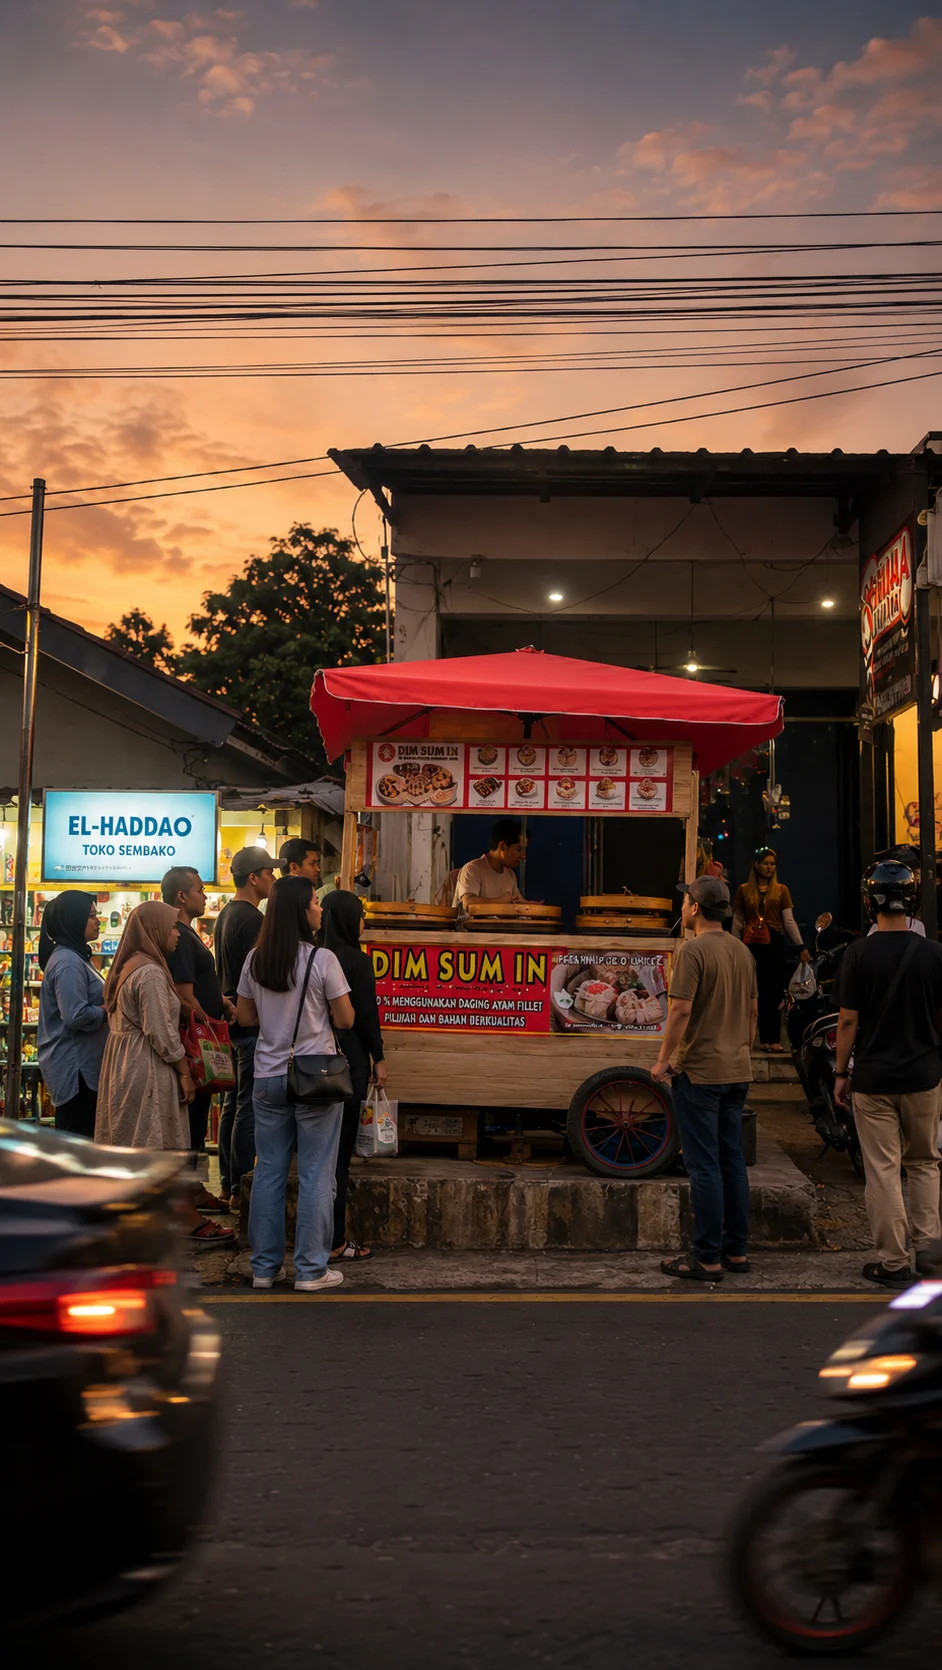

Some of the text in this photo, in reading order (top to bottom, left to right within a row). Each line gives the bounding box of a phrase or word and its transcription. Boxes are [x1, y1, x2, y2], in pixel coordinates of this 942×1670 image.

[398, 745, 458, 756] DIM SUM IN
[68, 815, 192, 837] EL-HADDAO
[82, 844, 176, 857] TOKO SEMBAKO
[371, 948, 548, 986] DIM SUM IN
[392, 996, 457, 1009] MENGGUNAKAN
[458, 998, 490, 1010] DAGING
[491, 1000, 515, 1011] AYAM
[517, 1000, 543, 1012] FILLET
